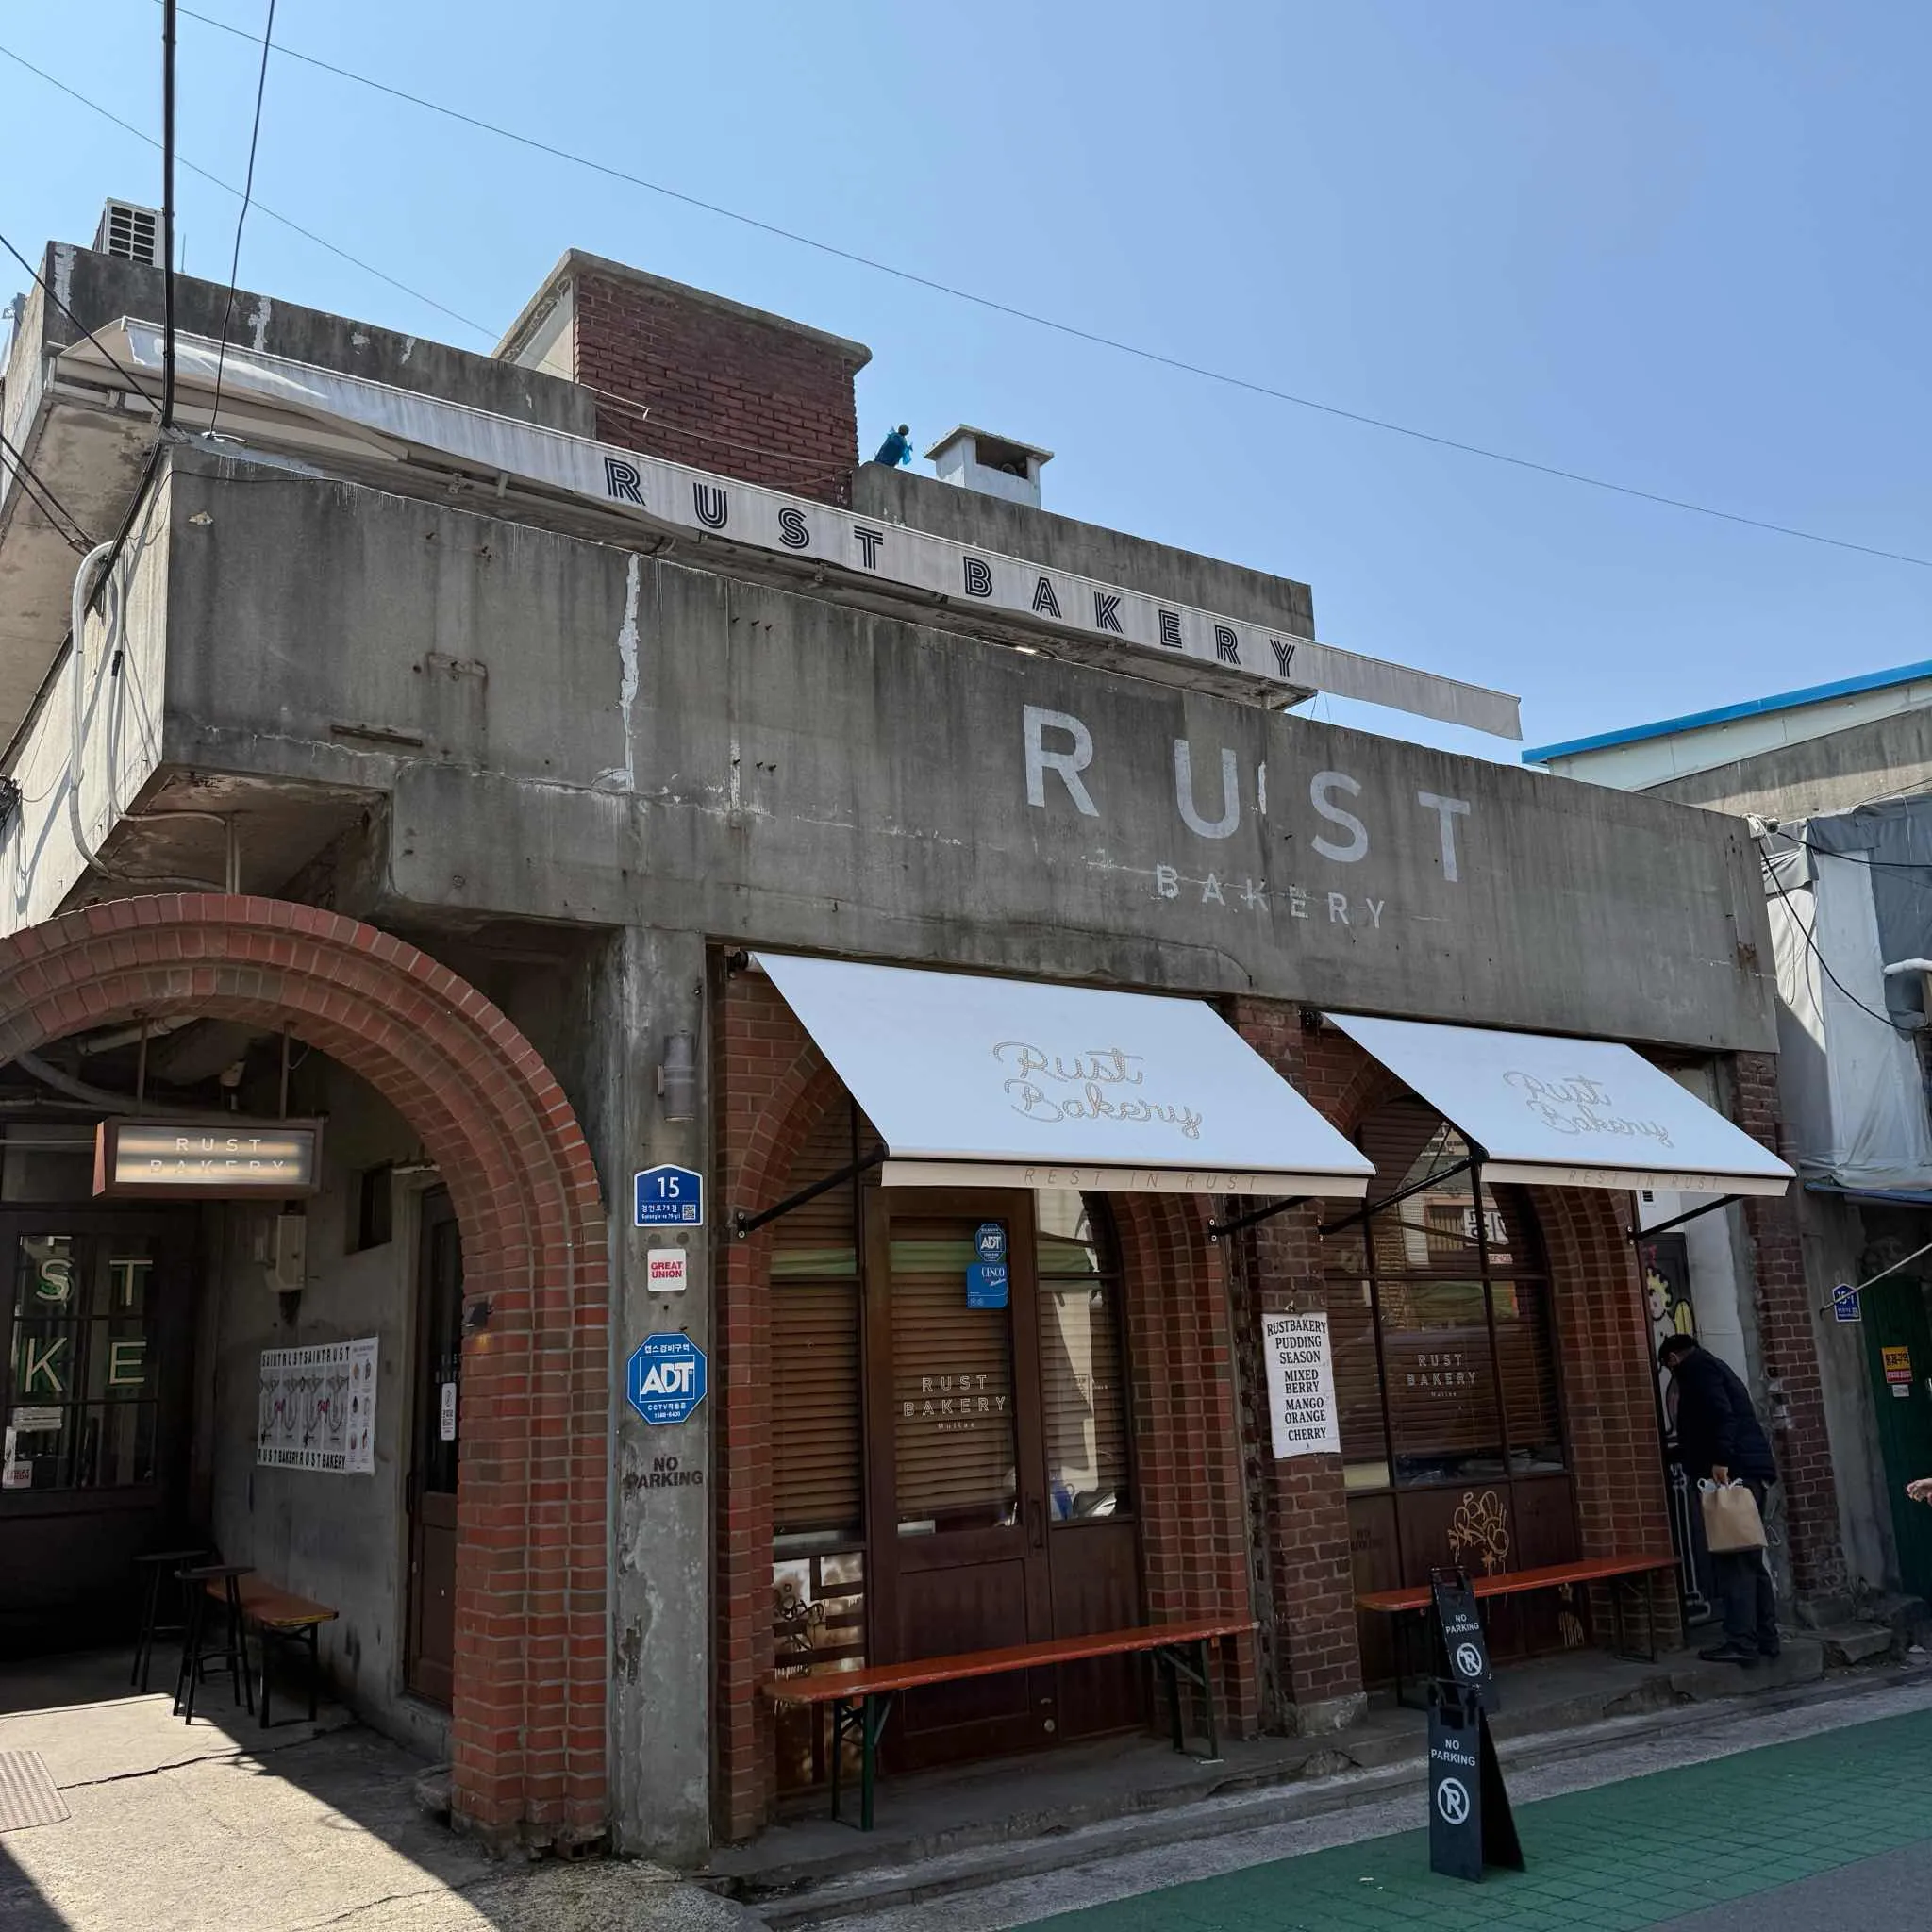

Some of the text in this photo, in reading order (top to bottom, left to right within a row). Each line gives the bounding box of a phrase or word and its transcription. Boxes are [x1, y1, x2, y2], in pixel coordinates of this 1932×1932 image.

[605, 456, 1296, 678] RUST BAKERY
[1023, 704, 1471, 884] RUST
[1155, 862, 1386, 930] BAKERY
[993, 1041, 1144, 1084] Rust
[1503, 1072, 1612, 1106] Rust
[1003, 1078, 1203, 1140] Bakery
[1526, 1100, 1675, 1149] Bakery
[175, 1138, 263, 1152] RUST
[150, 1159, 286, 1175] BAKERY
[657, 1176, 680, 1198] 15
[1024, 1168, 1259, 1191] REST IN RUST
[1568, 1169, 1620, 1184] REST
[1671, 1176, 1718, 1190] RUST
[980, 1235, 1002, 1250] ADT
[651, 1260, 684, 1271] GREAT
[651, 1269, 683, 1278] UNION
[1267, 1319, 1327, 1337] RUSTBAKERY
[1275, 1335, 1322, 1350] PUDDING
[1279, 1350, 1321, 1364] SEASON
[1417, 1353, 1462, 1367] RUST
[641, 1362, 694, 1395] ADT
[922, 1374, 988, 1392] RUST
[1284, 1369, 1319, 1382] MIXED
[1407, 1372, 1476, 1387] BAKERY
[1285, 1380, 1320, 1394] BERRY
[903, 1396, 1006, 1417] BAKERY
[1285, 1397, 1324, 1411] MANGO
[1284, 1409, 1326, 1424] ORANGE
[1288, 1427, 1327, 1441] CHERRY
[653, 1456, 679, 1473] NO
[625, 1470, 704, 1490] PARKING
[1455, 1613, 1468, 1623] NO
[1445, 1622, 1480, 1633] PARKING
[1444, 1739, 1460, 1752] NO
[1430, 1748, 1476, 1768] PARKING
